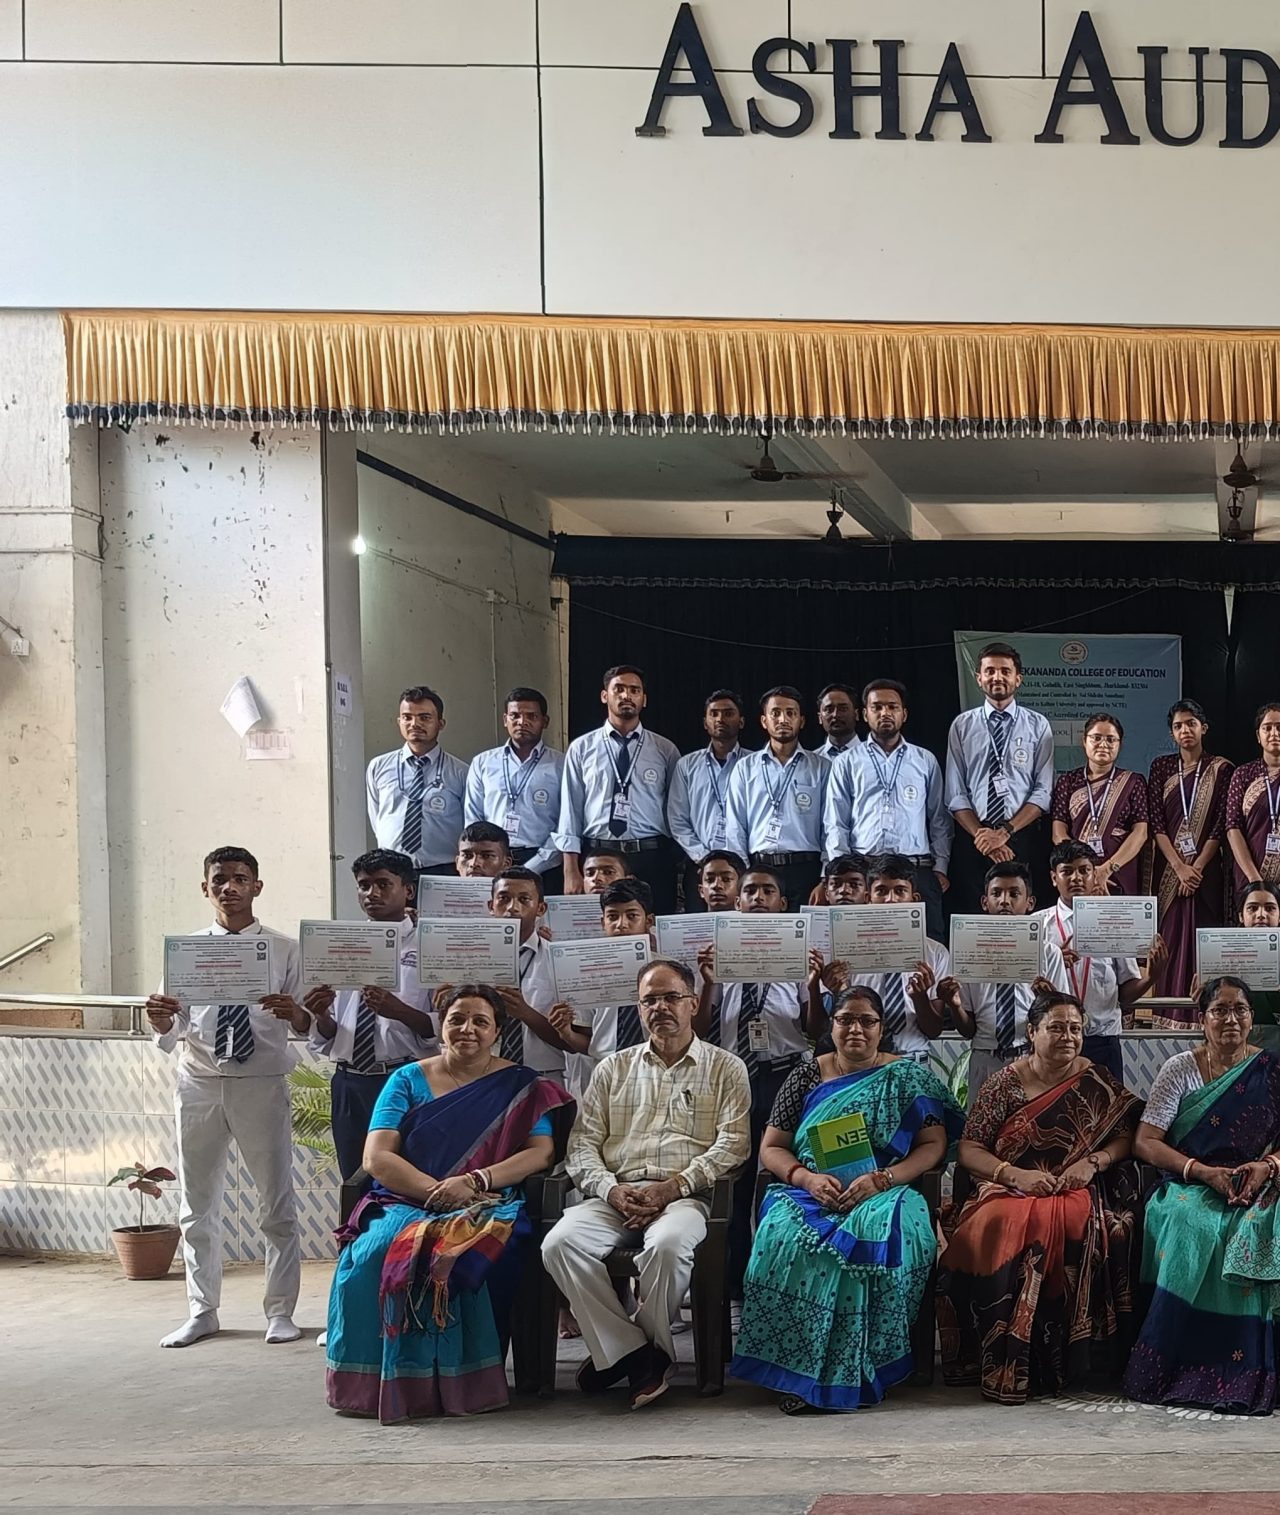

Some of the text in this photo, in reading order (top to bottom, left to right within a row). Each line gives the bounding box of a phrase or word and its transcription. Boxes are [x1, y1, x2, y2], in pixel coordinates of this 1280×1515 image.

[634, 2, 993, 141] ASHA
[1068, 668, 1105, 677] COLLEGE
[1105, 668, 1116, 677] OF
[1118, 668, 1166, 678] EDUCATION
